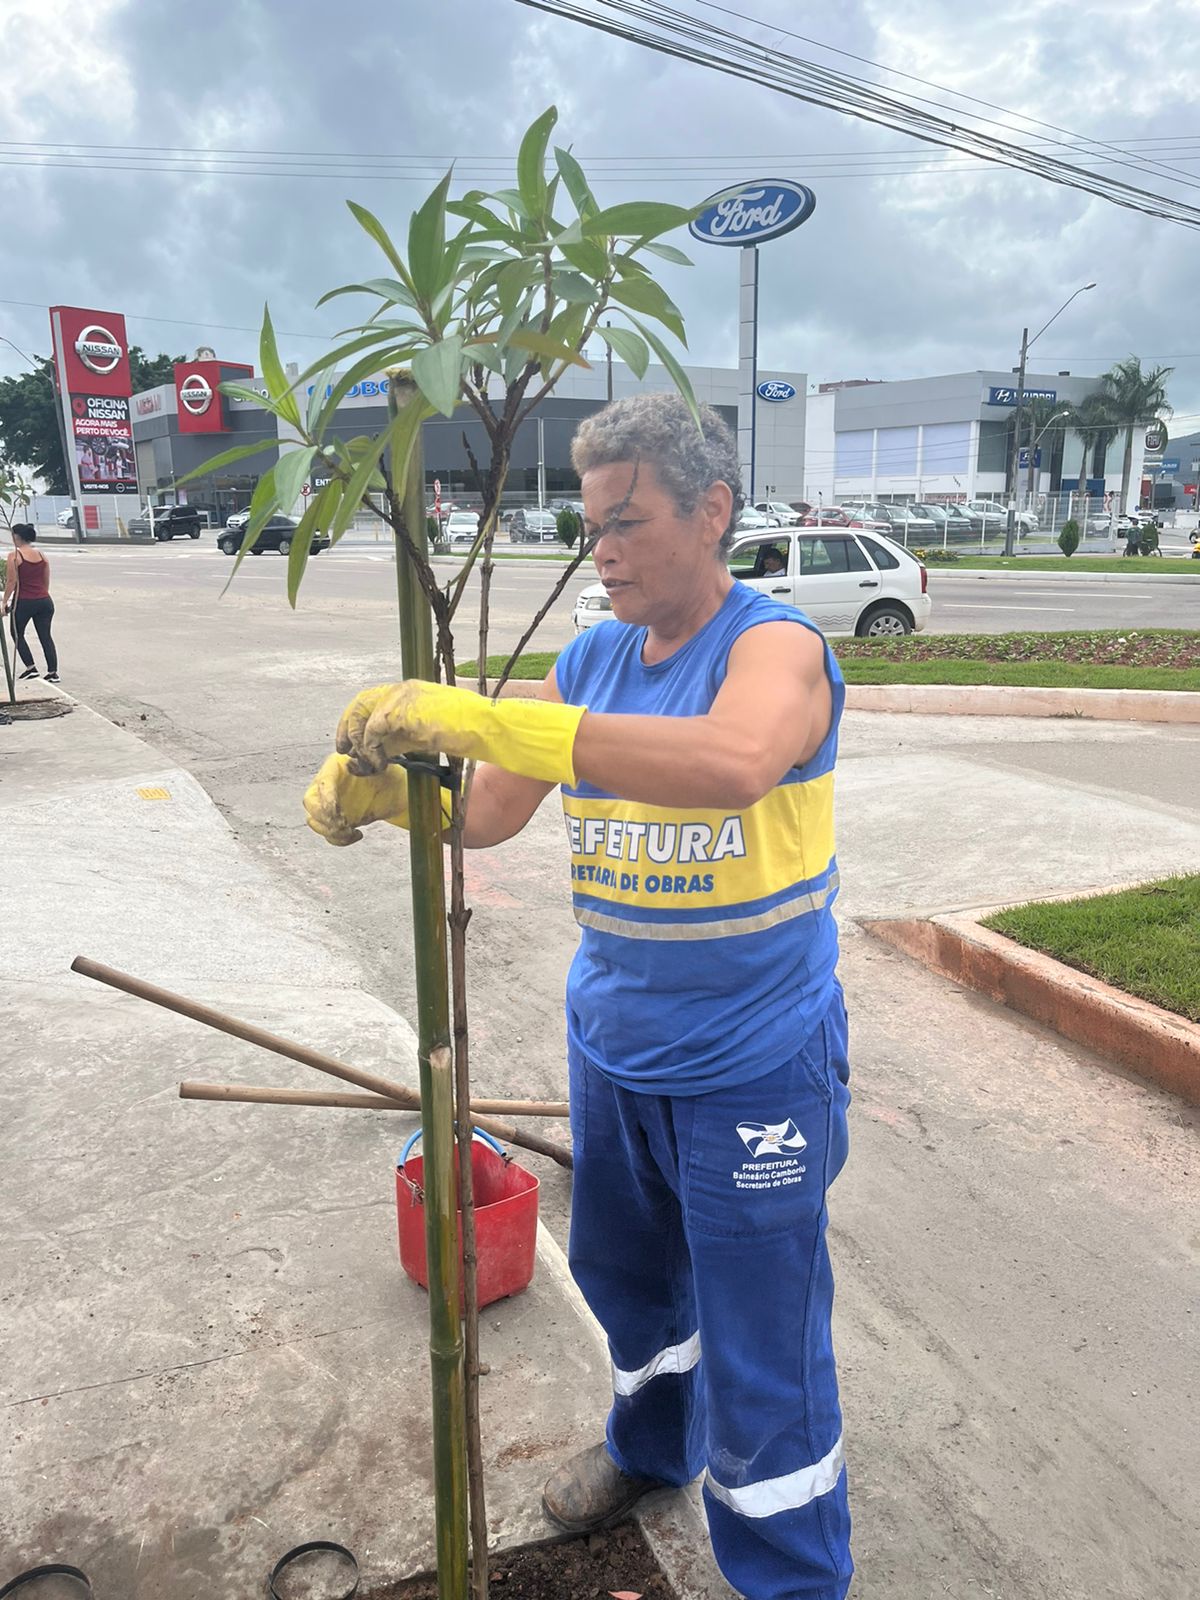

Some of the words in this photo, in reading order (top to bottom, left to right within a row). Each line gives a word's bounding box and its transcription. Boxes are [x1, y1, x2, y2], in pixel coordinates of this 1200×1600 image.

[710, 189, 784, 236] Ford
[82, 344, 120, 355] NISSAN
[765, 383, 791, 398] Ford
[87, 398, 127, 410] OFICINA
[88, 408, 126, 420] NISSAN
[75, 418, 101, 427] AGORA
[101, 419, 118, 428] MAIS
[76, 427, 100, 435] PERTO
[100, 427, 110, 436] DE
[620, 873, 639, 892] DE
[644, 874, 714, 893] OBRAS
[742, 1159, 798, 1170] PREFEITURA
[733, 1172, 770, 1180] Balneário
[736, 1180, 771, 1189] Secretaria
[772, 1179, 781, 1187] de
[782, 1175, 802, 1185] Obras
